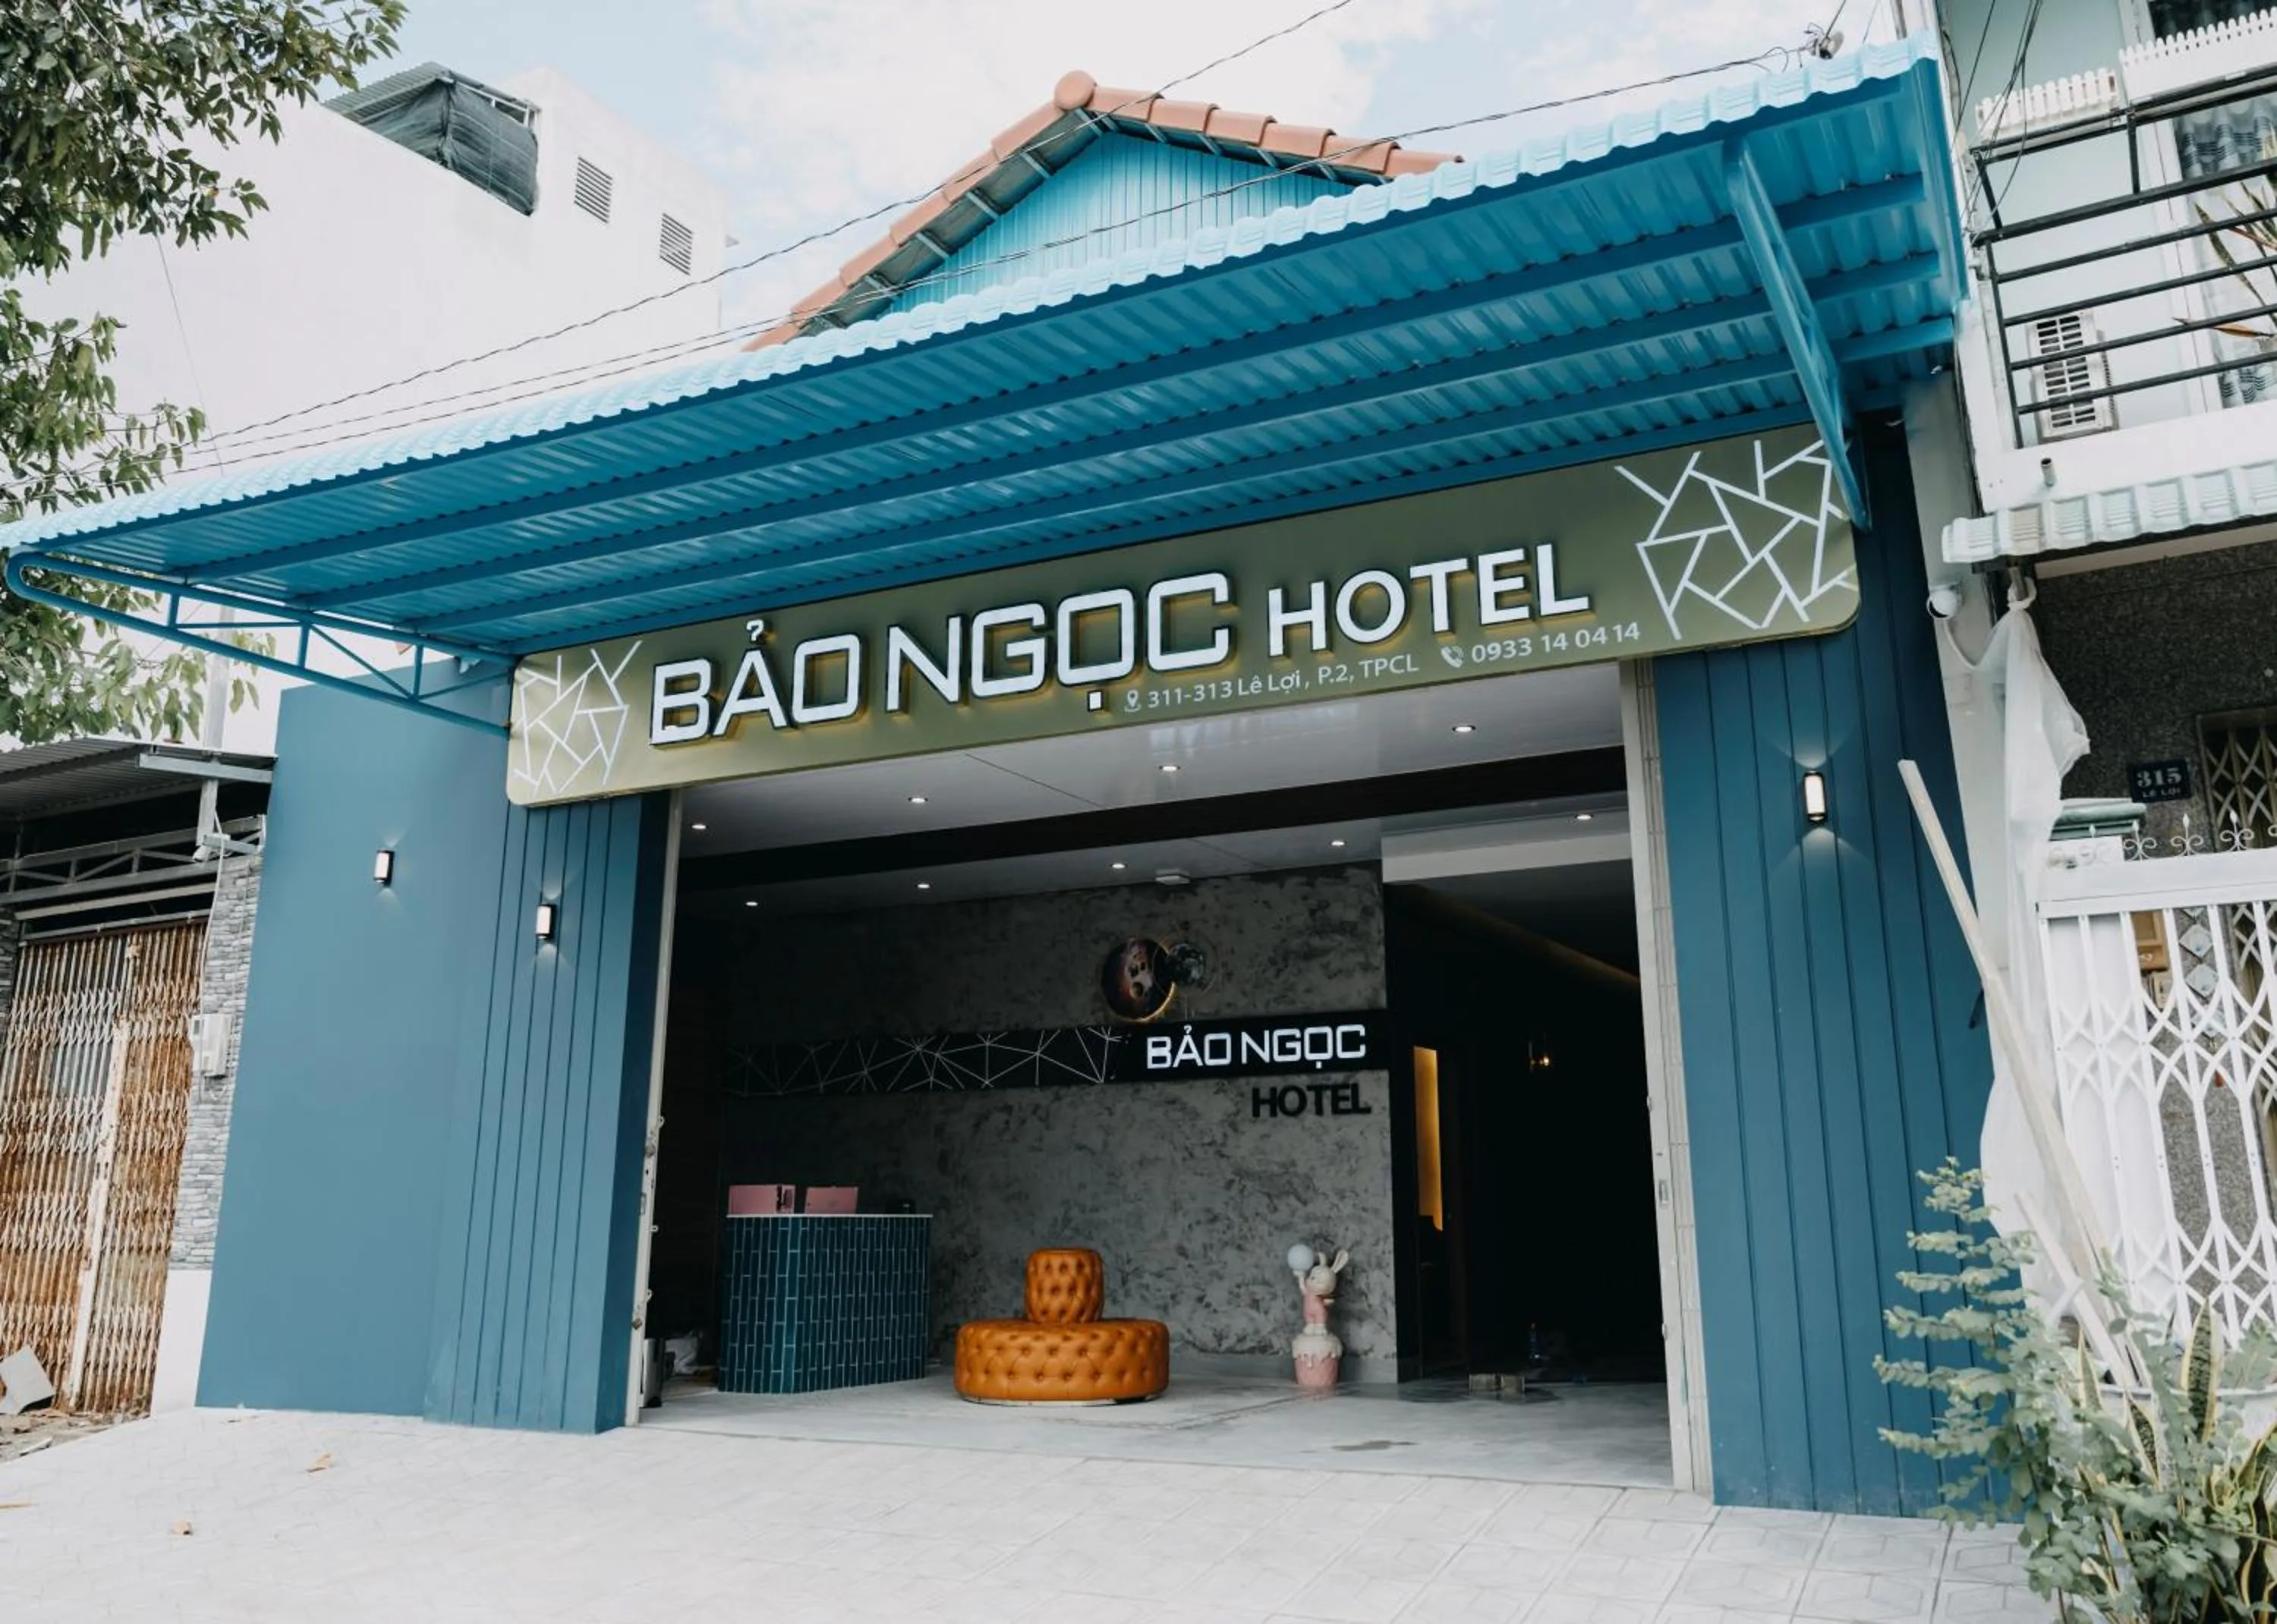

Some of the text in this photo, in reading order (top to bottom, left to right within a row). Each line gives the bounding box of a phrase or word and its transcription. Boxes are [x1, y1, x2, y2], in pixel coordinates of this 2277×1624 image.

[650, 543, 1590, 747] BẢO NGỌC HOTEL
[1471, 622, 1641, 664] 0933 14 04 14
[1148, 680, 1233, 708] 311-313
[1237, 676, 1261, 696] Lê
[1318, 664, 1355, 685] P.2,
[1359, 653, 1419, 678] TPCL
[2137, 767, 2182, 788] 315
[1147, 1024, 1365, 1069] BẢO NGỌC
[1252, 1083, 1372, 1118] HOTEL
